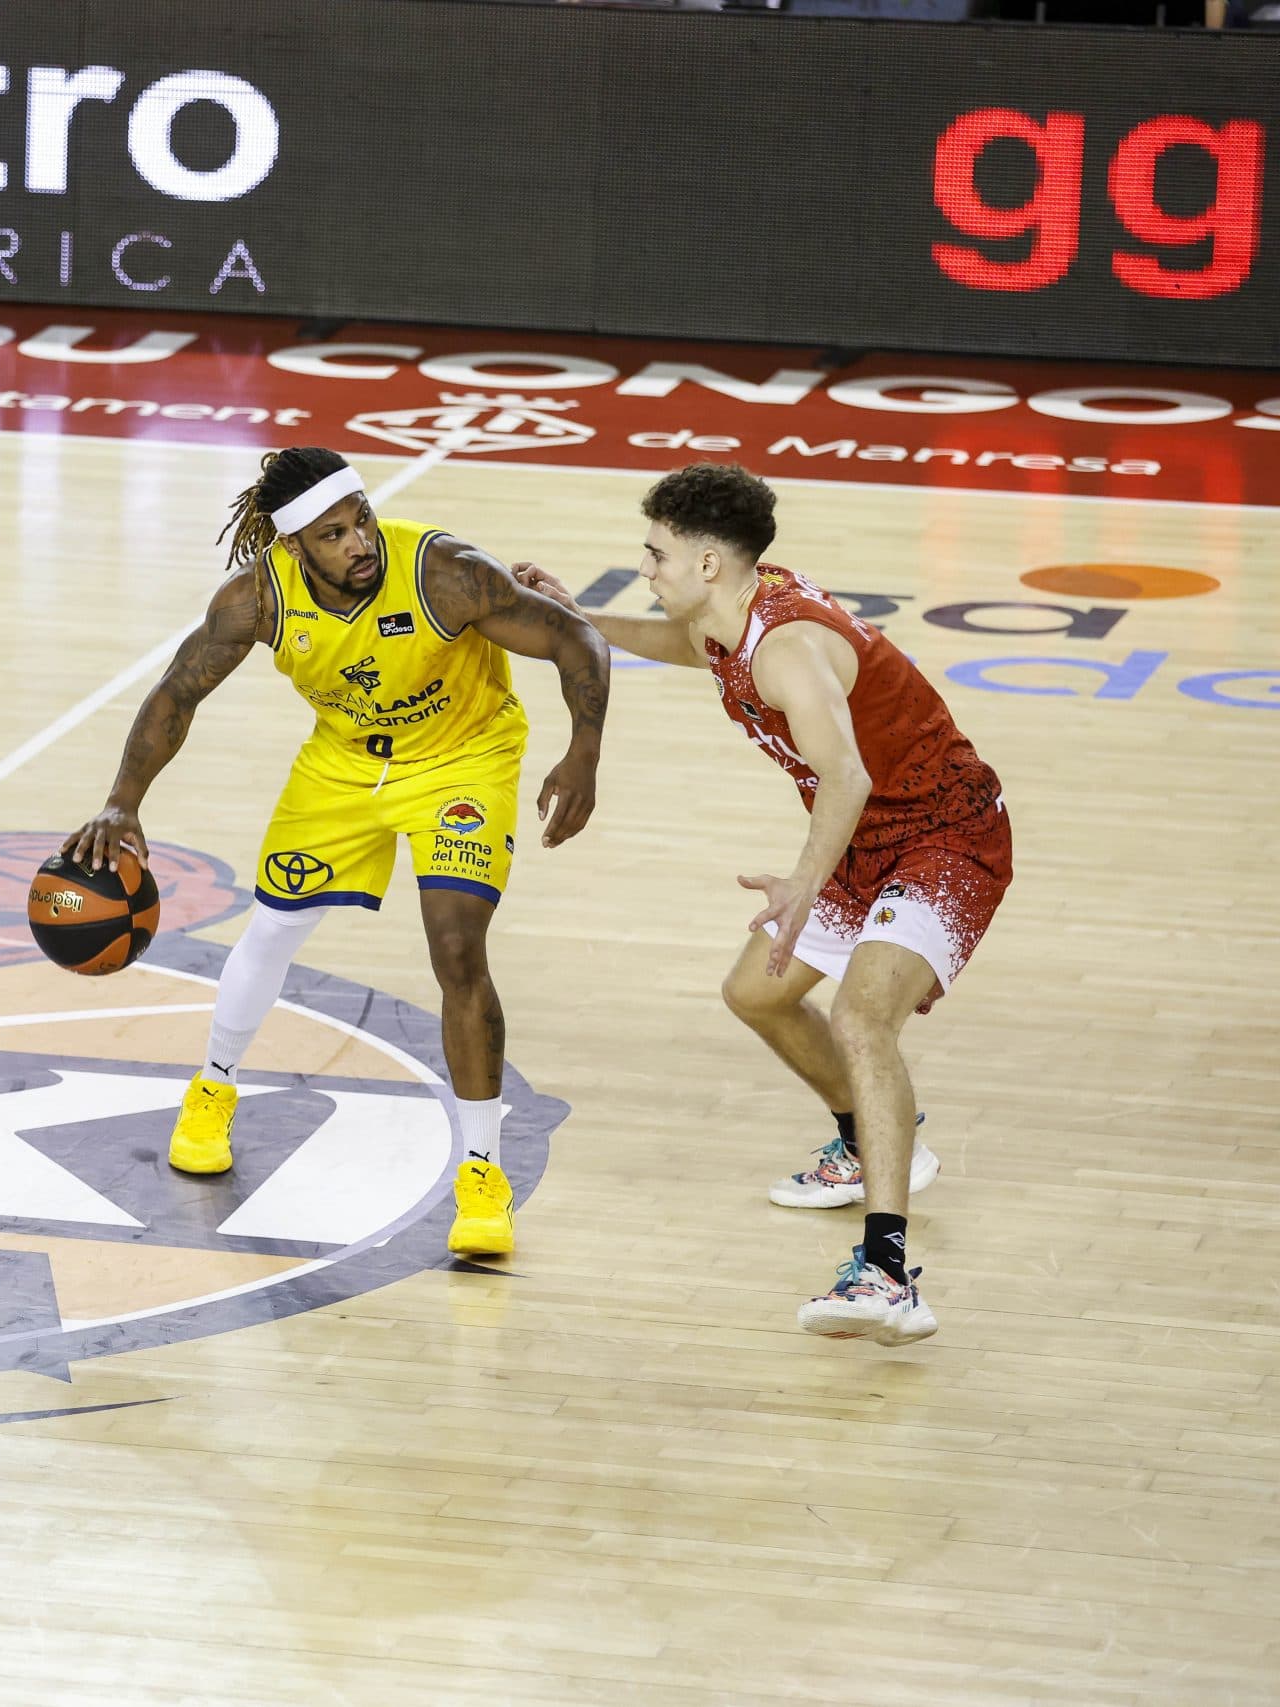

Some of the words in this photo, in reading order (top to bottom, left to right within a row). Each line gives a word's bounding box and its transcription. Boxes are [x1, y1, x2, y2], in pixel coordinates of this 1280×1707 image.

[931, 106, 1265, 300] gg
[266, 342, 1280, 432] CONGO
[627, 429, 743, 454] de
[766, 434, 1162, 476] Manresa
[366, 734, 394, 759] 0
[463, 795, 488, 813] NATURE
[435, 834, 492, 856] Poema
[432, 849, 453, 862] del
[458, 850, 492, 869] Mar
[429, 864, 491, 880] AQUARIUM
[882, 889, 900, 898] acb
